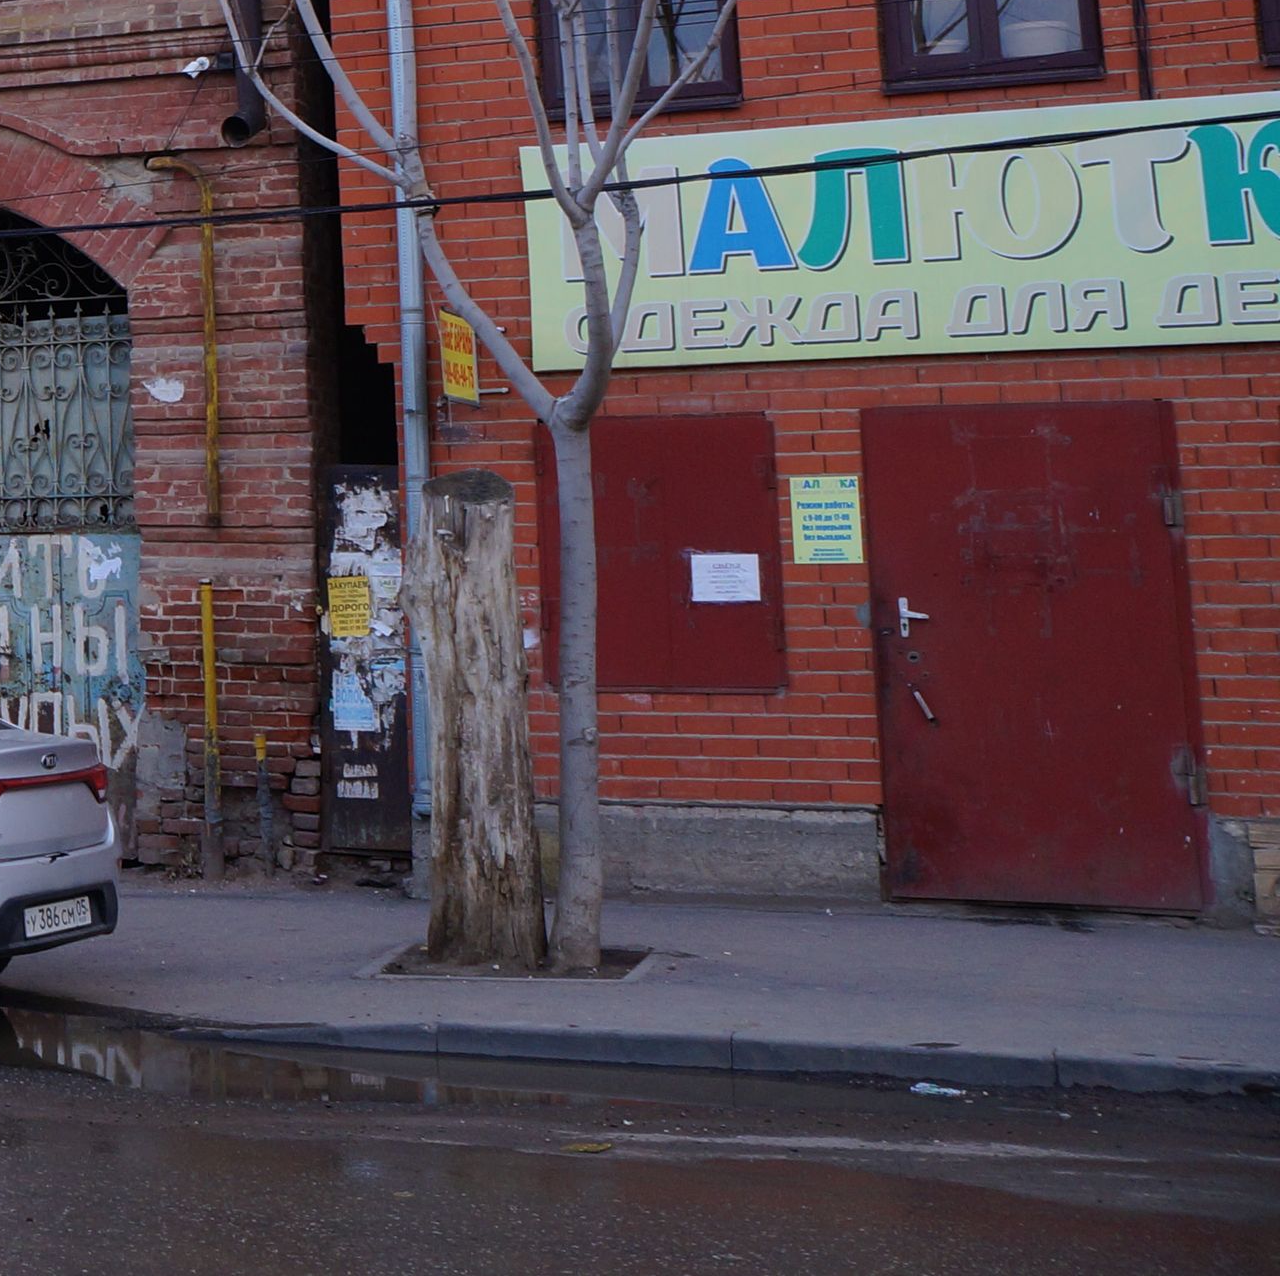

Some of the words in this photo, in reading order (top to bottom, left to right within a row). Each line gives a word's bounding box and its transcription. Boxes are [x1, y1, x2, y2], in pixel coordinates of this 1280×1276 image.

[945, 277, 1128, 337] ДЛЯ
[794, 479, 857, 489] АЛКА
[329, 580, 369, 590] ЗАКУПАЕМ
[331, 603, 369, 613] ДОРОГО
[30, 906, 76, 932] У386СМ
[76, 899, 88, 915] 05
